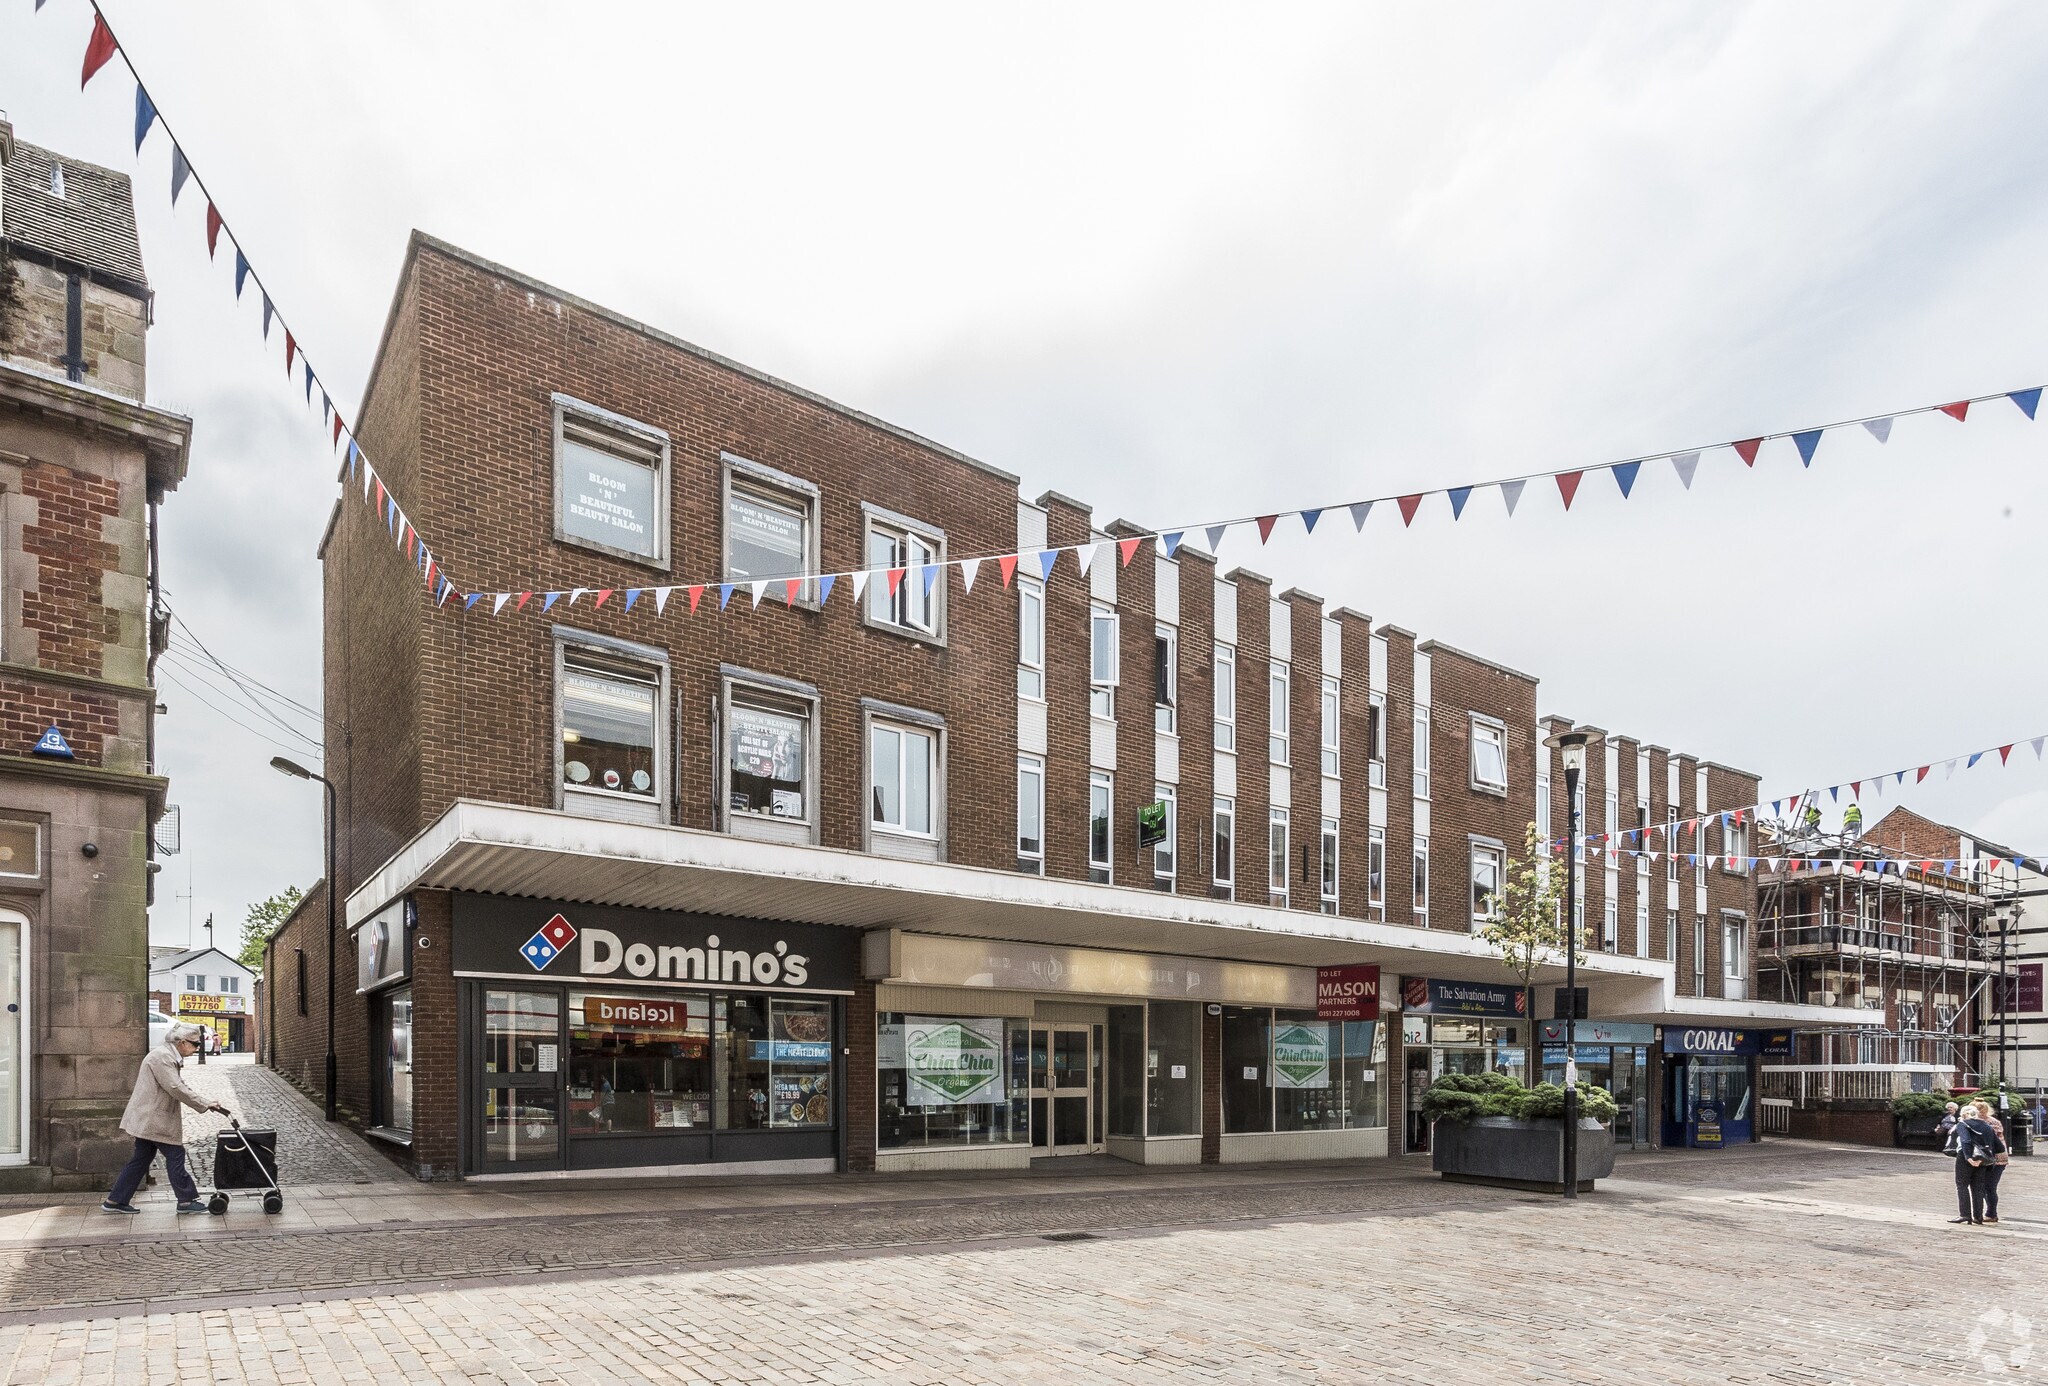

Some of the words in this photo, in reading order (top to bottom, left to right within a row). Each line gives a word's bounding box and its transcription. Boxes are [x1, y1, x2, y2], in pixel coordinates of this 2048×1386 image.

[589, 472, 626, 492] BLOOM
[580, 494, 634, 519] BEAUTIFUL
[570, 504, 610, 523] BEAUTY
[612, 516, 643, 533] SALON
[742, 516, 767, 528] BEAUTY
[768, 524, 788, 535] SALON
[1152, 804, 1161, 813] LET
[580, 928, 808, 985] Domino's
[1319, 982, 1375, 996] MASON
[1439, 986, 1453, 999] The
[1454, 988, 1485, 1001] Salvation
[1487, 991, 1506, 1005] Army
[938, 1037, 972, 1046] Natural
[1684, 1030, 1735, 1051] CORAL
[776, 1048, 787, 1056] THE
[938, 1078, 972, 1088] Organic
[781, 1091, 800, 1099] £19.99
